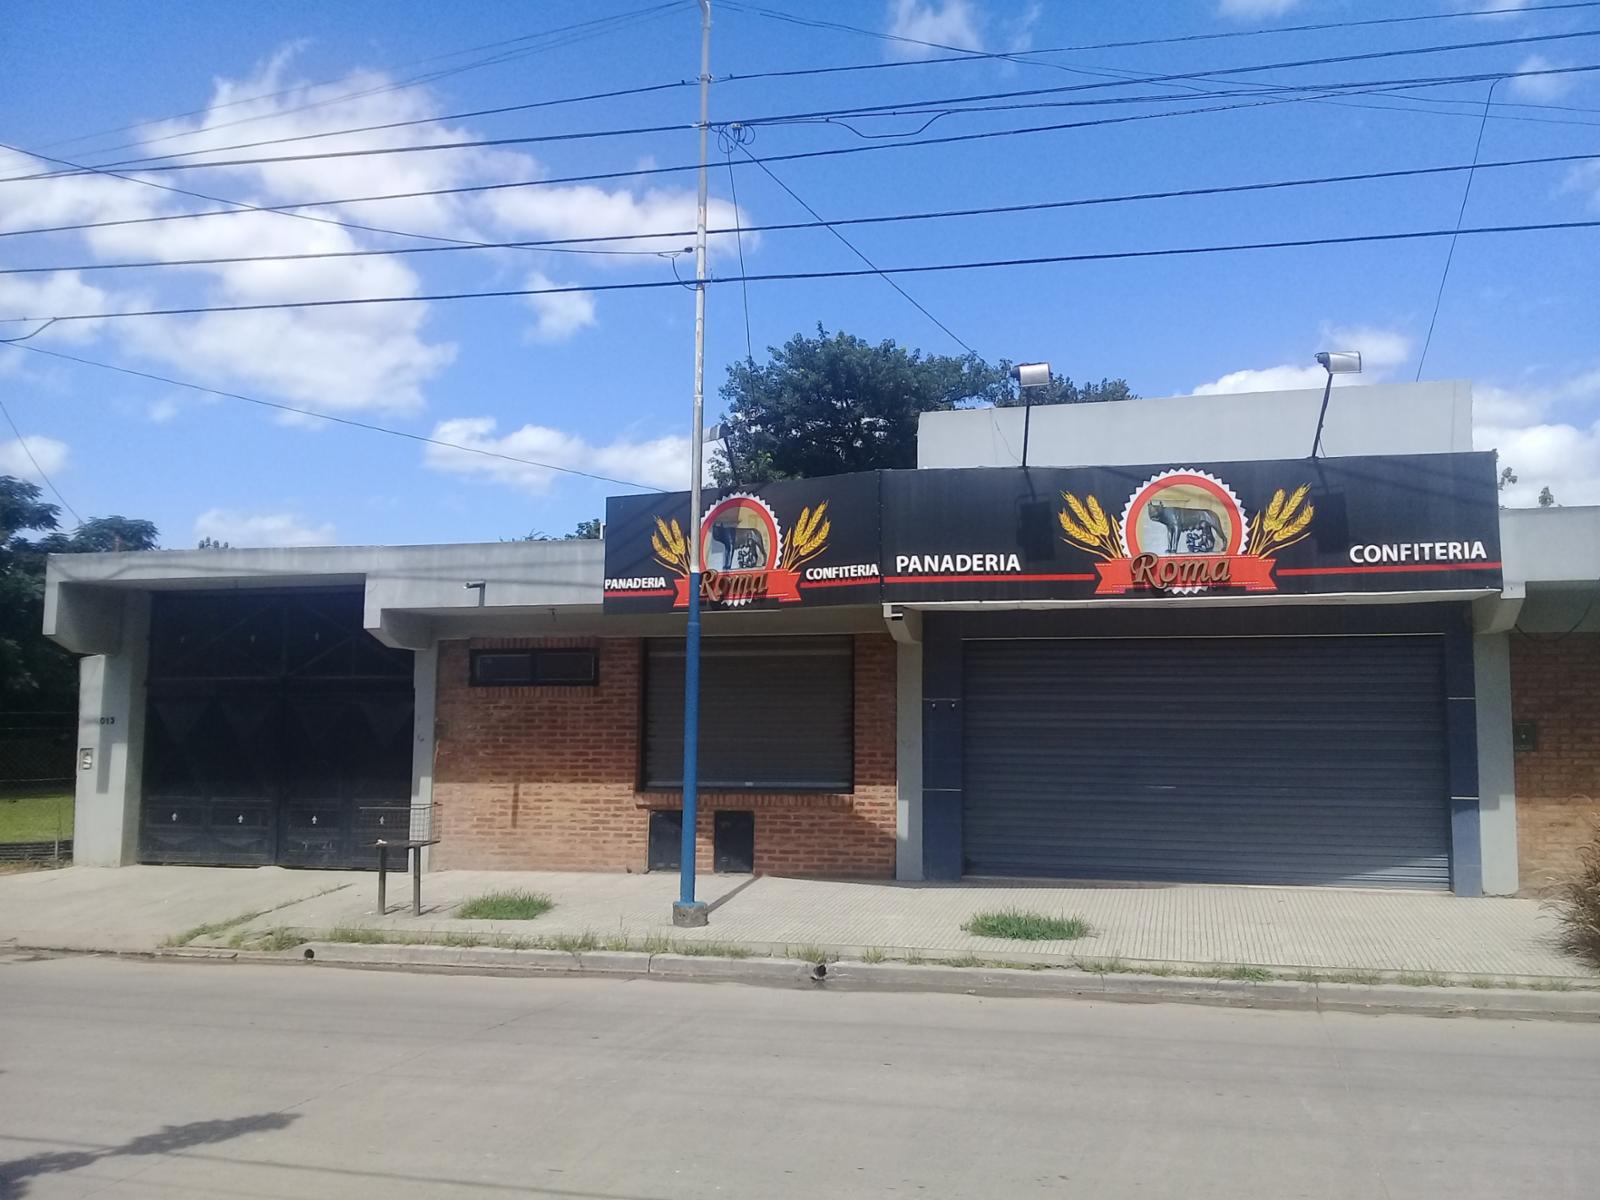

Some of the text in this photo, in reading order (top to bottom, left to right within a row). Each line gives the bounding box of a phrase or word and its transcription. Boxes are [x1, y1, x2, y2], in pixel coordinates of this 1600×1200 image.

[1349, 541, 1487, 563] CONFITERIA
[806, 564, 880, 580] CONFITERIA
[895, 554, 1021, 574] PANADERIA
[1131, 551, 1232, 589] Roma
[604, 577, 666, 590] PANADERIA
[700, 568, 769, 601] Roma
